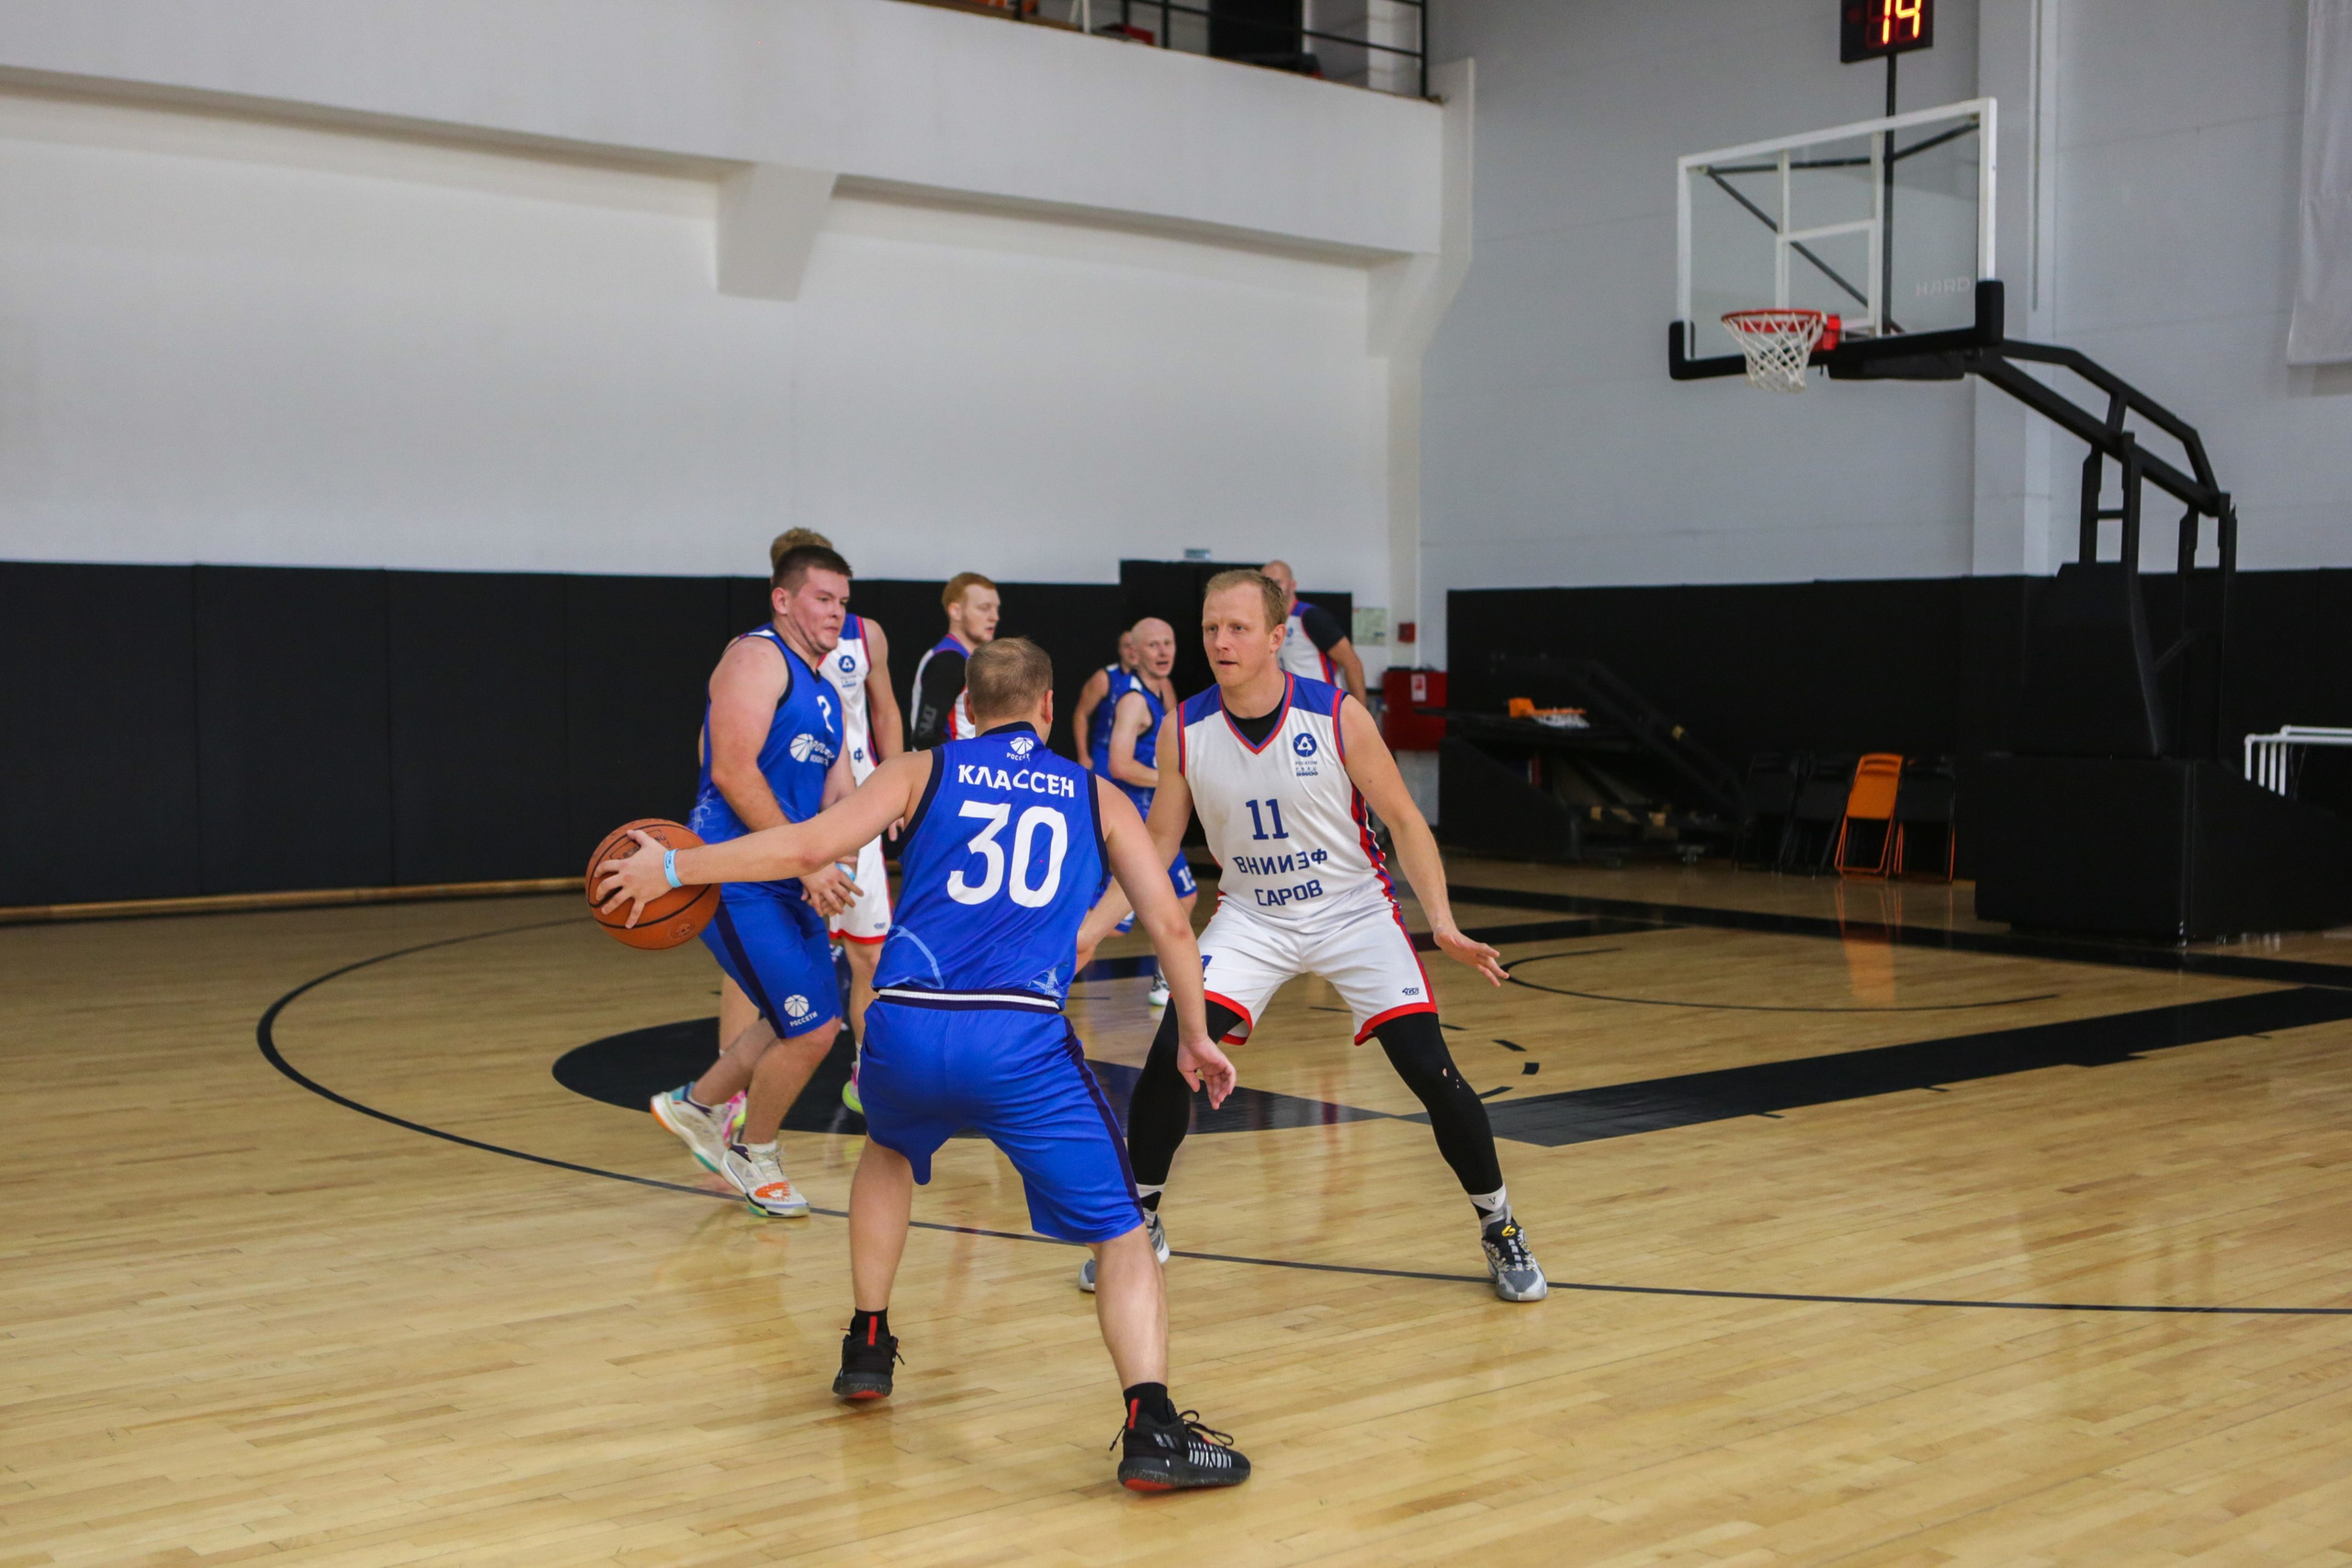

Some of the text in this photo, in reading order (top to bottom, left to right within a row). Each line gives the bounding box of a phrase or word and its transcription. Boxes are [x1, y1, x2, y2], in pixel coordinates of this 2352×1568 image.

[958, 764, 1075, 798] КЛАССЕН
[1245, 798, 1289, 840] 11
[946, 800, 1069, 908] 30
[1232, 848, 1328, 875] ВНИИЭФ
[1254, 879, 1323, 907] САРОВ
[789, 1010, 819, 1028] РОССЕТИ
